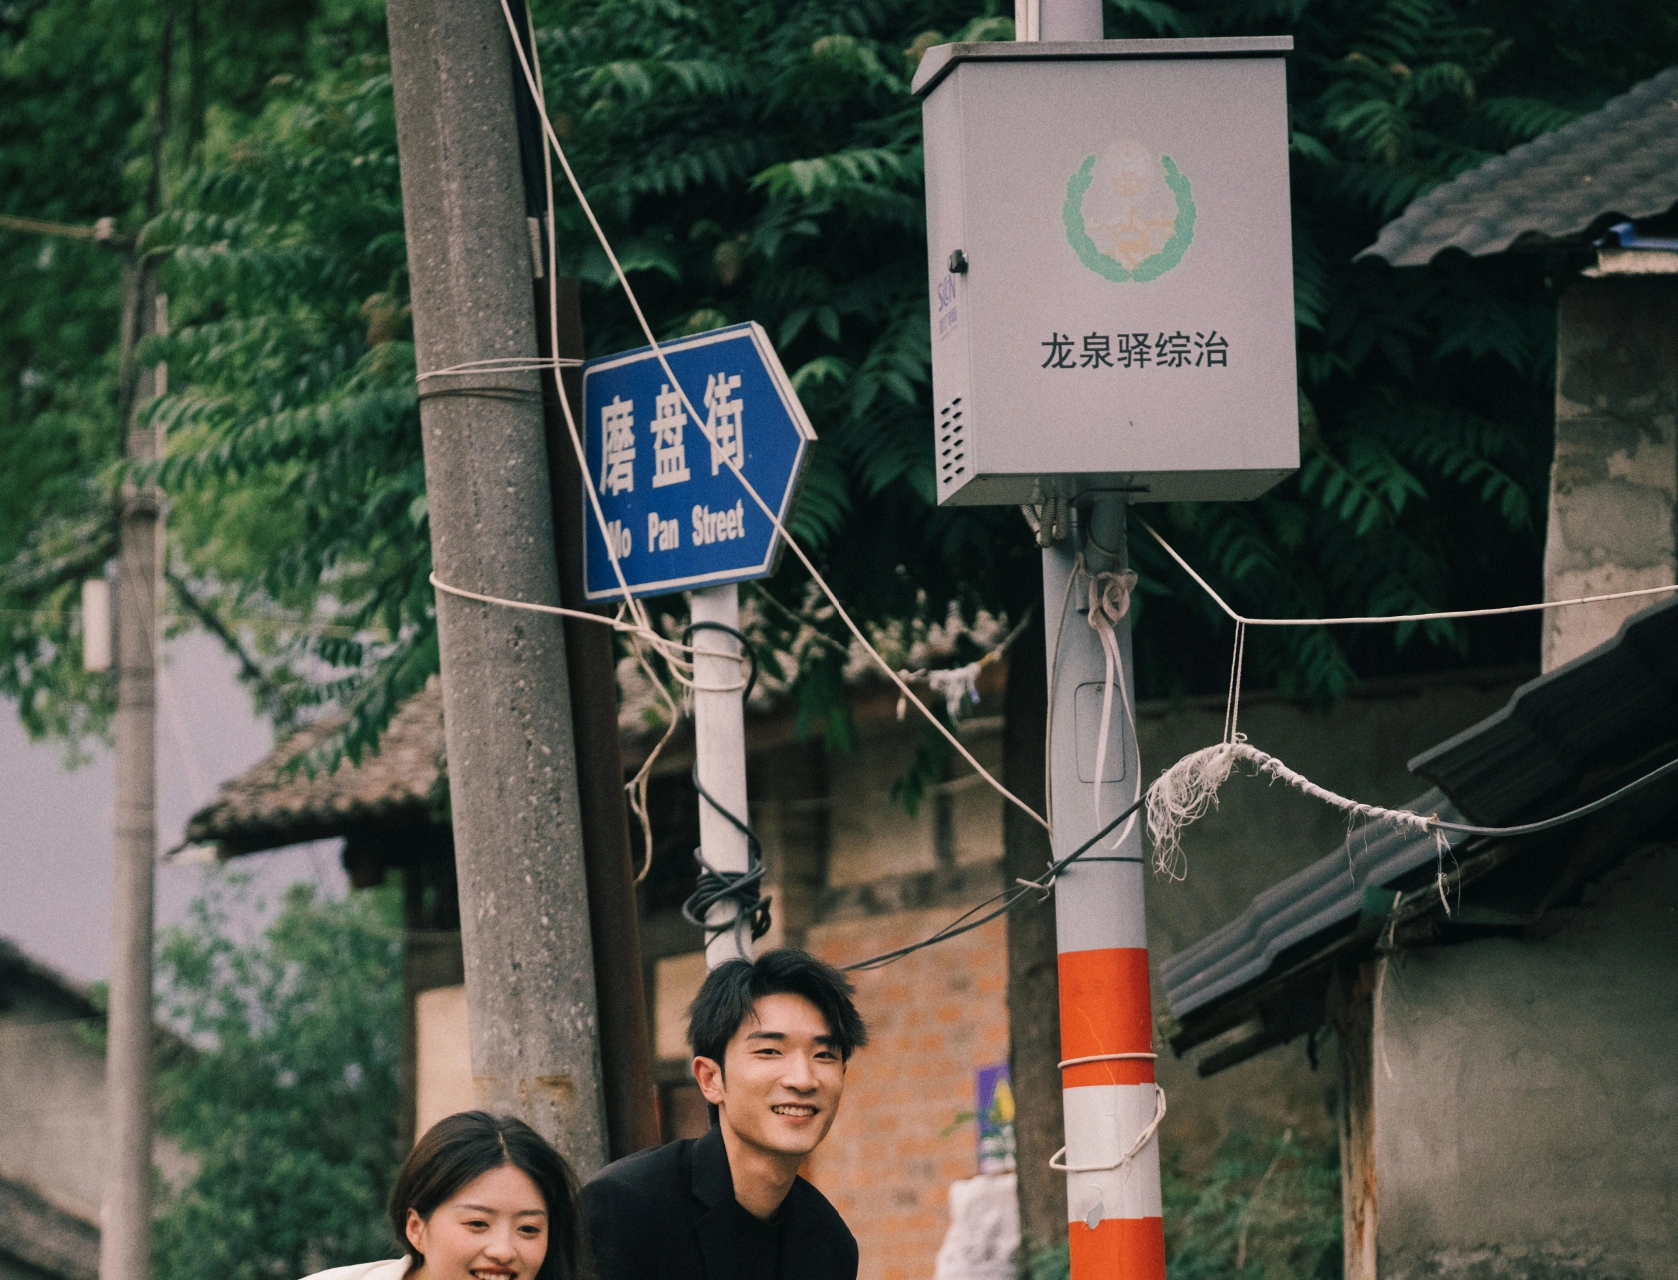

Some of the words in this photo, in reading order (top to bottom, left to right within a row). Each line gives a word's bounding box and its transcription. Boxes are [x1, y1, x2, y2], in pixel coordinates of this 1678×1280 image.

[1041, 330, 1230, 370] 龙泉驿综治
[600, 372, 744, 497] 磨盘街
[648, 511, 679, 553] Pan
[692, 498, 745, 547] Street
